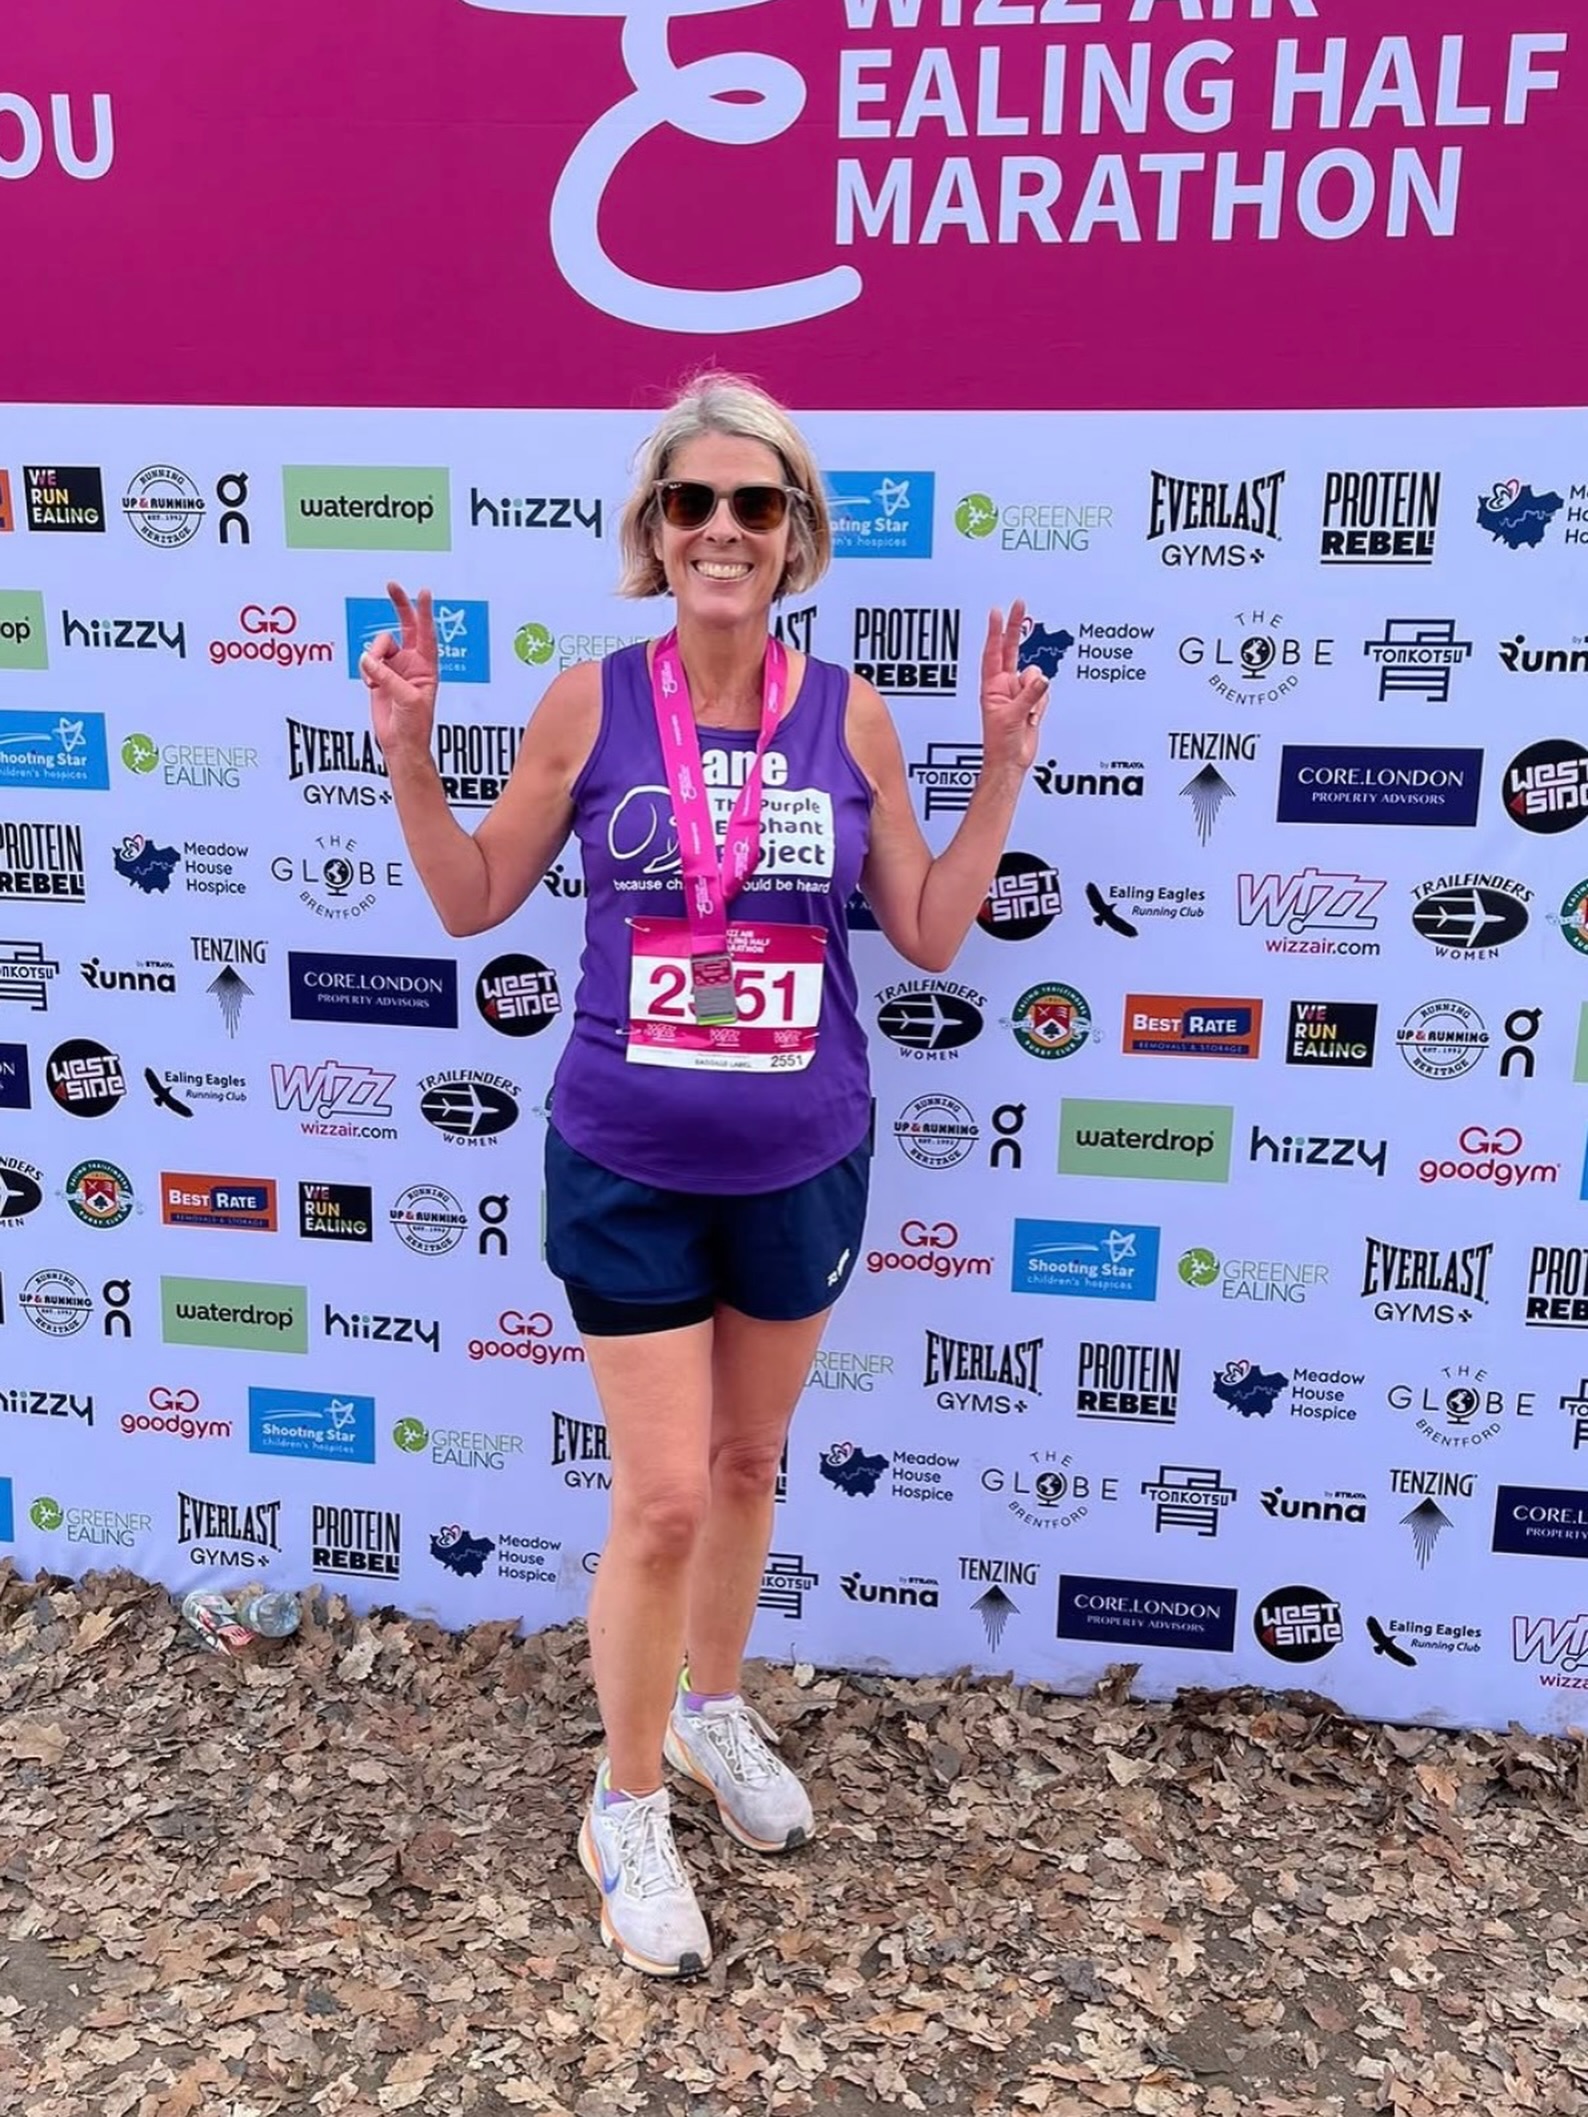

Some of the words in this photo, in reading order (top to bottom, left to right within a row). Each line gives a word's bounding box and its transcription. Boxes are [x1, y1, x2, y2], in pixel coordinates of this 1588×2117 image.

[838, 40, 1235, 139] EALING
[1270, 32, 1568, 131] HALF
[835, 146, 1464, 245] MARATHON
[29, 469, 57, 486] WE
[31, 488, 69, 504] RUN
[122, 497, 138, 508] UP
[150, 498, 205, 509] RUNNING
[1147, 470, 1285, 540] EVERLAST
[1323, 471, 1441, 528] PROTEIN
[33, 507, 99, 524] EALING
[300, 493, 434, 524] waterdrop
[471, 488, 602, 538] hiizzy
[1003, 506, 1113, 528] GREENER
[874, 518, 909, 532] Star
[1002, 530, 1089, 551] EALING
[1161, 544, 1247, 567] GYMS
[1234, 611, 1283, 629] THE
[62, 610, 186, 658] hiizzy
[854, 608, 960, 660] PROTEIN
[1079, 624, 1154, 639] Meadow
[209, 639, 332, 666] goodgym
[1078, 646, 1133, 660] House
[1373, 649, 1463, 664] TONKOTSU
[1077, 666, 1147, 682] Hospice
[1209, 674, 1299, 705] BRENTFORD
[162, 744, 257, 767] GREENER
[1169, 733, 1256, 760] TENZING
[57, 753, 87, 766] Star
[164, 769, 239, 787] EALING
[1033, 760, 1143, 796] Runna
[1299, 767, 1464, 787] CORE.LONDON
[1312, 792, 1377, 803] PROPERTY
[1382, 793, 1446, 805] ADVISORS
[184, 842, 248, 857] Meadow
[316, 835, 357, 852] THE
[185, 860, 233, 875] House
[187, 880, 246, 894] Hospice
[613, 880, 661, 891] because
[776, 880, 793, 892] be
[797, 880, 830, 894] heard
[1109, 886, 1153, 902] Ealing
[1158, 887, 1205, 902] Eagles
[1410, 872, 1535, 903] TRAILFINDERS
[300, 891, 376, 919] BRENTFORD
[993, 893, 1062, 922] SIDE
[1131, 905, 1176, 919] Running
[1179, 906, 1204, 918] Club
[191, 937, 266, 964] TENZING
[1265, 938, 1380, 955] wizzair.com
[1434, 946, 1500, 961] WOMEN
[80, 957, 176, 992] Runna
[304, 971, 443, 993] CORE.LONDON
[482, 969, 555, 999] WEST
[376, 996, 429, 1008] ADVISORS
[648, 964, 795, 1022] 251
[874, 979, 988, 1007] TRAILFINDERS
[499, 995, 562, 1019] SIDE
[1297, 1005, 1327, 1020] WE
[1133, 1014, 1182, 1031] BEST
[1190, 1016, 1237, 1033] RATE
[1296, 1024, 1336, 1040] RUN
[1397, 1030, 1414, 1040] UP
[1428, 1031, 1490, 1043] RUNNING
[900, 1049, 959, 1061] WOMEN
[1293, 1042, 1367, 1059] EALING
[51, 1055, 119, 1082] WEST
[770, 1055, 803, 1068] 2551
[66, 1075, 126, 1100] SIDE
[164, 1071, 203, 1087] Ealing
[205, 1074, 246, 1087] Eagles
[416, 1069, 521, 1097] TRAILFINDERS
[186, 1089, 222, 1102] Running
[225, 1091, 247, 1101] Club
[300, 1121, 398, 1140] wizzair.com
[442, 1132, 497, 1146] WOMEN
[1076, 1129, 1214, 1156] waterdrop
[1250, 1126, 1387, 1176] hiizzy
[1419, 1160, 1557, 1187] goodgym
[169, 1189, 209, 1206] BEST
[216, 1193, 257, 1209] RATE
[304, 1186, 329, 1199] WE
[305, 1203, 340, 1216] RUN
[305, 1219, 367, 1235] EALING
[867, 1252, 991, 1278] goodgym
[1028, 1258, 1098, 1279] Shooting
[1102, 1262, 1134, 1277] Star
[1223, 1261, 1328, 1284] GREENER
[1361, 1237, 1494, 1302] EVERLAST
[1222, 1280, 1305, 1302] EALING
[177, 1304, 292, 1331] waterdrop
[1374, 1302, 1454, 1324] GYMS
[325, 1304, 439, 1352] hiizzy
[468, 1339, 584, 1364] goodgym
[924, 1329, 1043, 1393] EVERLAST
[1079, 1342, 1181, 1394] PROTEIN
[1293, 1368, 1365, 1385] Meadow
[1441, 1365, 1488, 1383] THE
[937, 1391, 1010, 1414] GYMS
[1292, 1386, 1345, 1402] House
[1290, 1404, 1357, 1421] Hospice
[121, 1413, 230, 1438] goodgym
[262, 1423, 323, 1442] Shooting
[326, 1429, 355, 1442] Star
[1415, 1418, 1501, 1448] BRENTFORD
[432, 1429, 523, 1454] GREENER
[432, 1449, 504, 1469] EALING
[893, 1451, 960, 1468] Meadow
[1030, 1451, 1073, 1467] THE
[892, 1468, 942, 1484] House
[1390, 1469, 1473, 1497] TENZING
[892, 1485, 953, 1502] Hospice
[1149, 1489, 1230, 1507] TONKOTSU
[1008, 1501, 1088, 1529] BRENTFORD
[1260, 1486, 1366, 1524] Runna
[66, 1508, 151, 1531] GREENER
[178, 1491, 280, 1550] EVERLAST
[313, 1505, 400, 1553] PROTEIN
[67, 1525, 135, 1547] EALING
[499, 1534, 562, 1551] Meadow
[190, 1547, 255, 1567] GYMS
[499, 1551, 545, 1567] House
[499, 1567, 556, 1583] Hospice
[960, 1557, 1040, 1585] TENZING
[840, 1572, 938, 1608] Runna
[1074, 1593, 1220, 1619] CORE.LONDON
[1262, 1602, 1339, 1630] WEST
[1148, 1621, 1205, 1633] ADVISORS
[1277, 1620, 1343, 1646] SIDE
[1389, 1619, 1432, 1638] Ealing
[1435, 1624, 1482, 1639] Eagles
[1411, 1638, 1455, 1653] Running
[1456, 1641, 1480, 1653] Club
